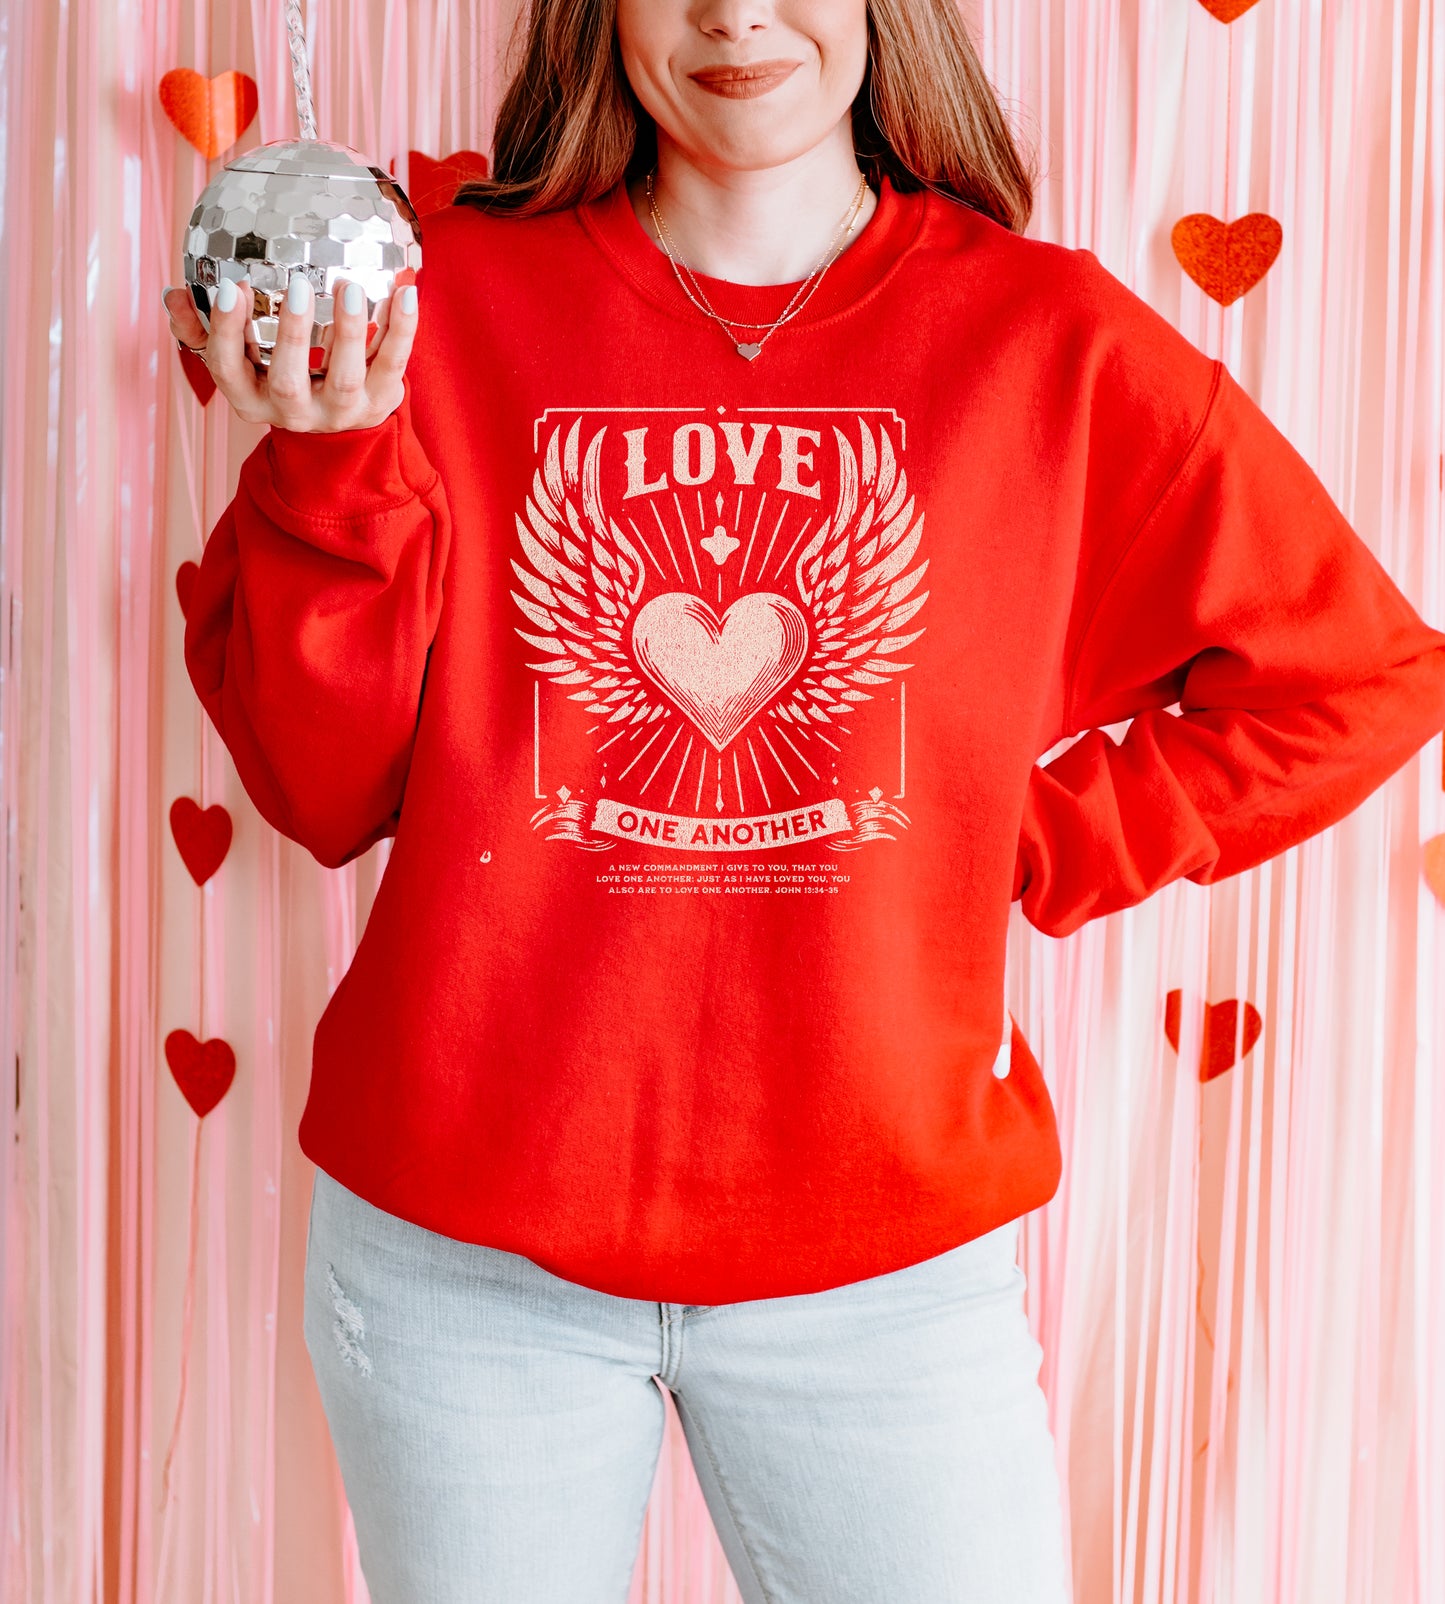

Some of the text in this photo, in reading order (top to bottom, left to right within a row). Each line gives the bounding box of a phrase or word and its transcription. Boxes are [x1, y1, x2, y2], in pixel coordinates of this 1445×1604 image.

[622, 421, 821, 500] LOVE
[617, 809, 827, 845] ONE ANOTHER
[608, 864, 616, 872] A
[618, 864, 641, 872] NEW
[643, 864, 719, 872] COMMANDMENT
[726, 864, 750, 872] GIVE
[751, 864, 765, 872] TO
[767, 864, 789, 873] YOU,
[791, 864, 817, 872] THAT
[818, 864, 838, 872] YOU
[596, 875, 621, 883] LOVE
[623, 875, 644, 883] ONE
[645, 875, 695, 883] ANOTHER:
[696, 875, 721, 883] JUST
[723, 875, 737, 883] AS
[745, 875, 771, 883] HAVE
[773, 875, 805, 883] LOVED
[807, 875, 829, 884] YOU,
[830, 875, 851, 883] YOU
[608, 886, 635, 894] ALSO
[637, 886, 657, 894] ARE
[659, 886, 673, 894] TO
[674, 886, 700, 894] LOVE
[701, 886, 722, 894] ONE
[724, 886, 773, 894] ANOTHER.
[774, 886, 802, 894] JOHN
